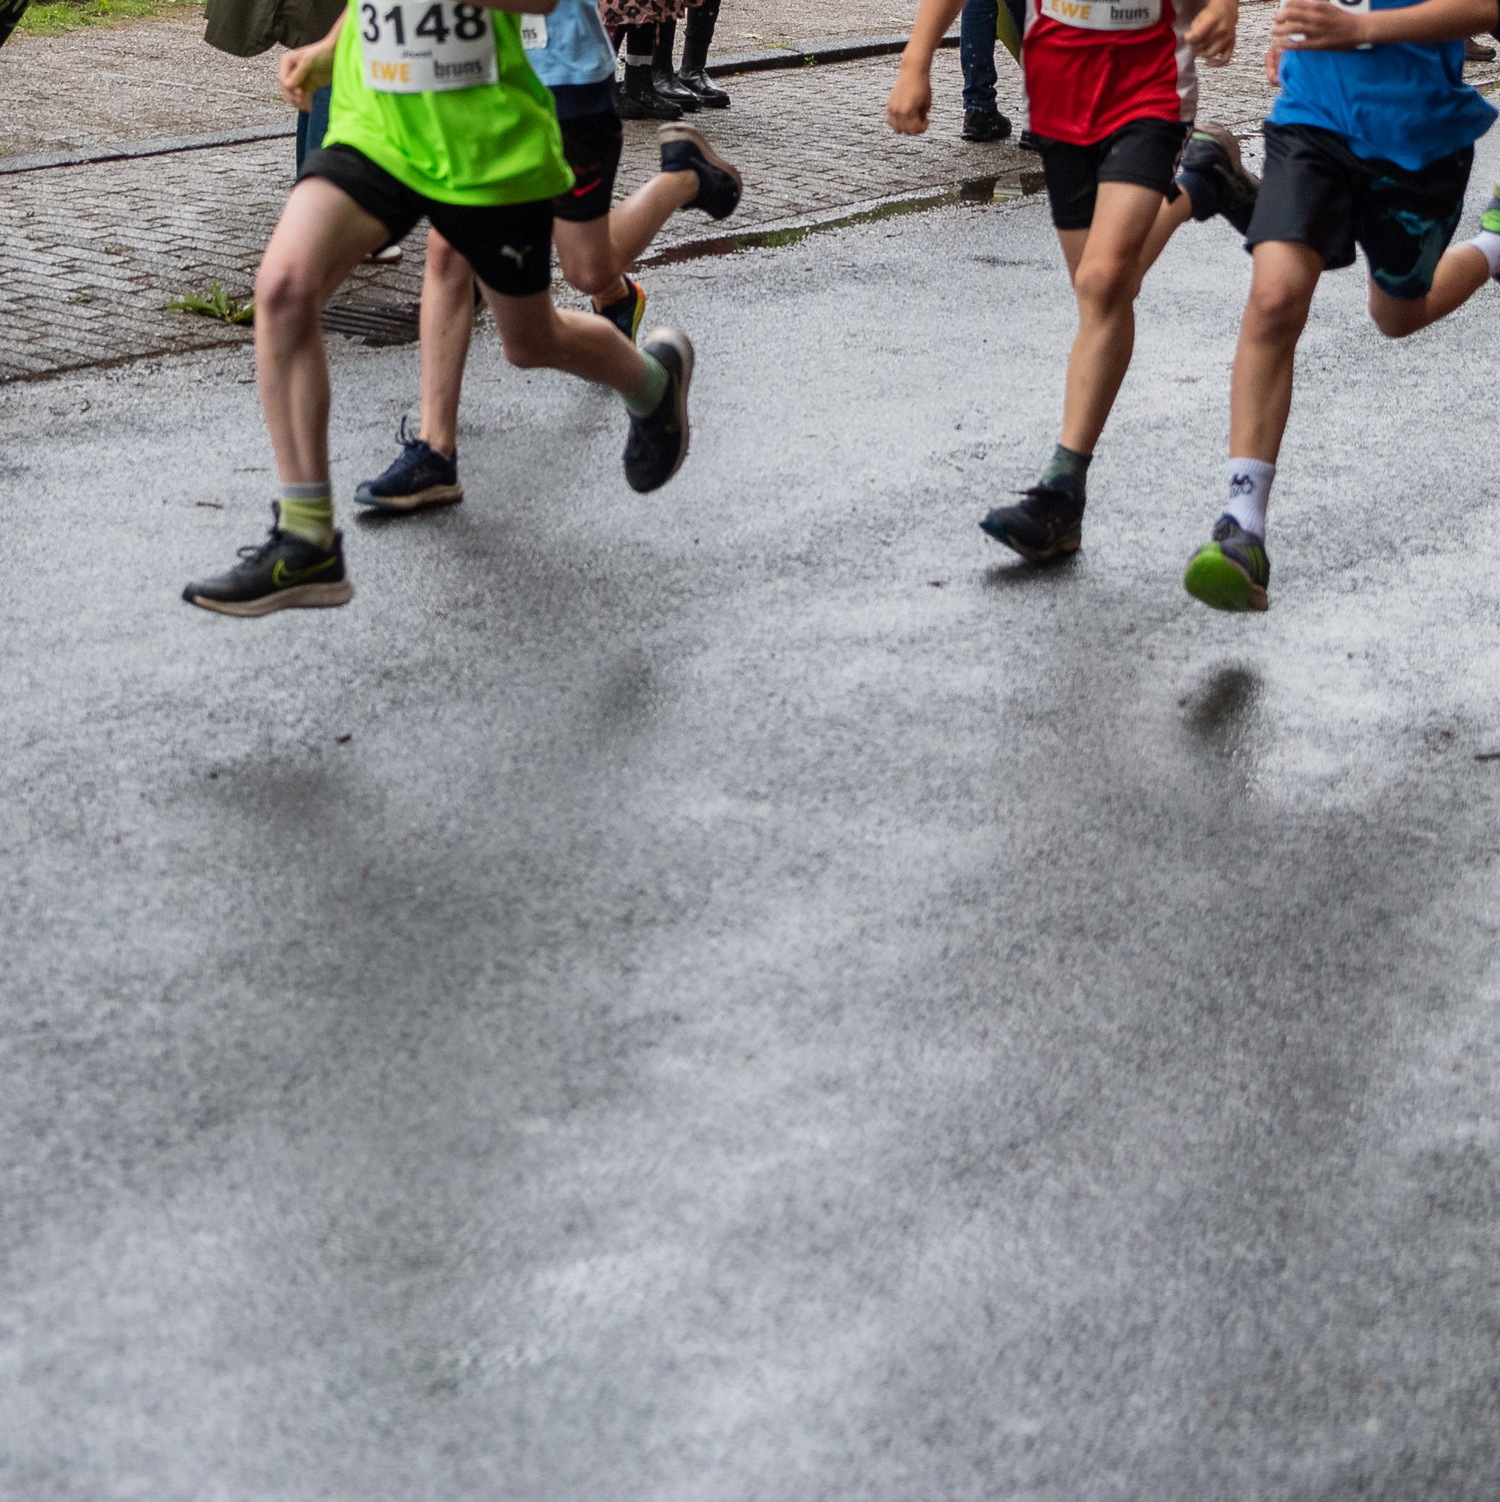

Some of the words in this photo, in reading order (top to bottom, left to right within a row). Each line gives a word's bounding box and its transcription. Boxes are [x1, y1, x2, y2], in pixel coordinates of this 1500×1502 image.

[362, 2, 487, 45] 3148
[1110, 5, 1149, 21] bruns
[371, 60, 412, 83] EWE
[434, 59, 483, 81] bruns
